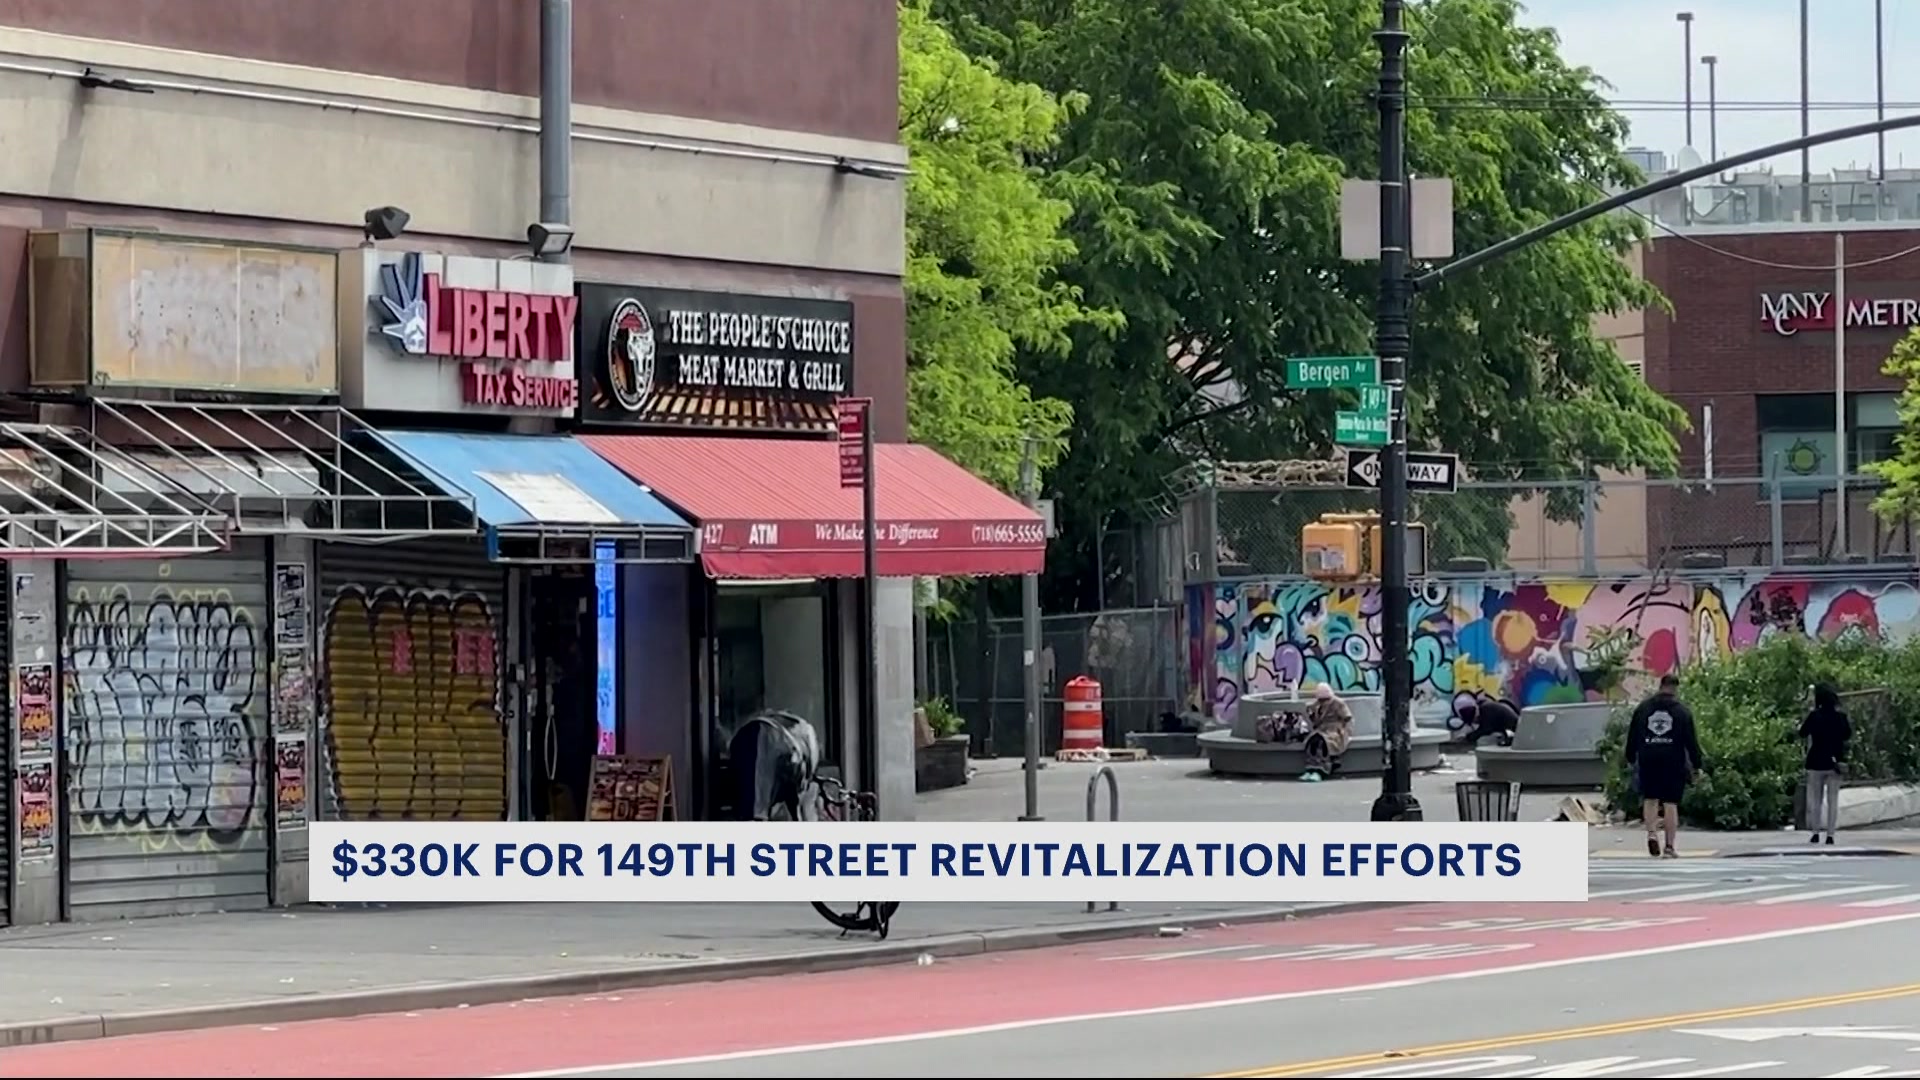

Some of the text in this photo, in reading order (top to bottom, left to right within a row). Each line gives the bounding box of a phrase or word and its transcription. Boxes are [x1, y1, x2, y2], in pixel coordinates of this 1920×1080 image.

[424, 272, 579, 361] LIBERTY
[1846, 299, 1920, 326] METR
[669, 310, 704, 344] THE
[709, 312, 787, 350] PEOPLE'S
[790, 317, 851, 354] CHOICE
[678, 354, 845, 391] MEAT MARKET & GRILL
[1299, 361, 1366, 387] Bergen Av
[472, 363, 508, 404] TAX
[511, 366, 579, 409] SERVICE
[1363, 463, 1442, 481] ON WAY
[704, 524, 724, 545] 427
[749, 524, 778, 545] ATM
[815, 523, 939, 546] We Make he Difference
[971, 524, 1044, 544] (718)665-5556
